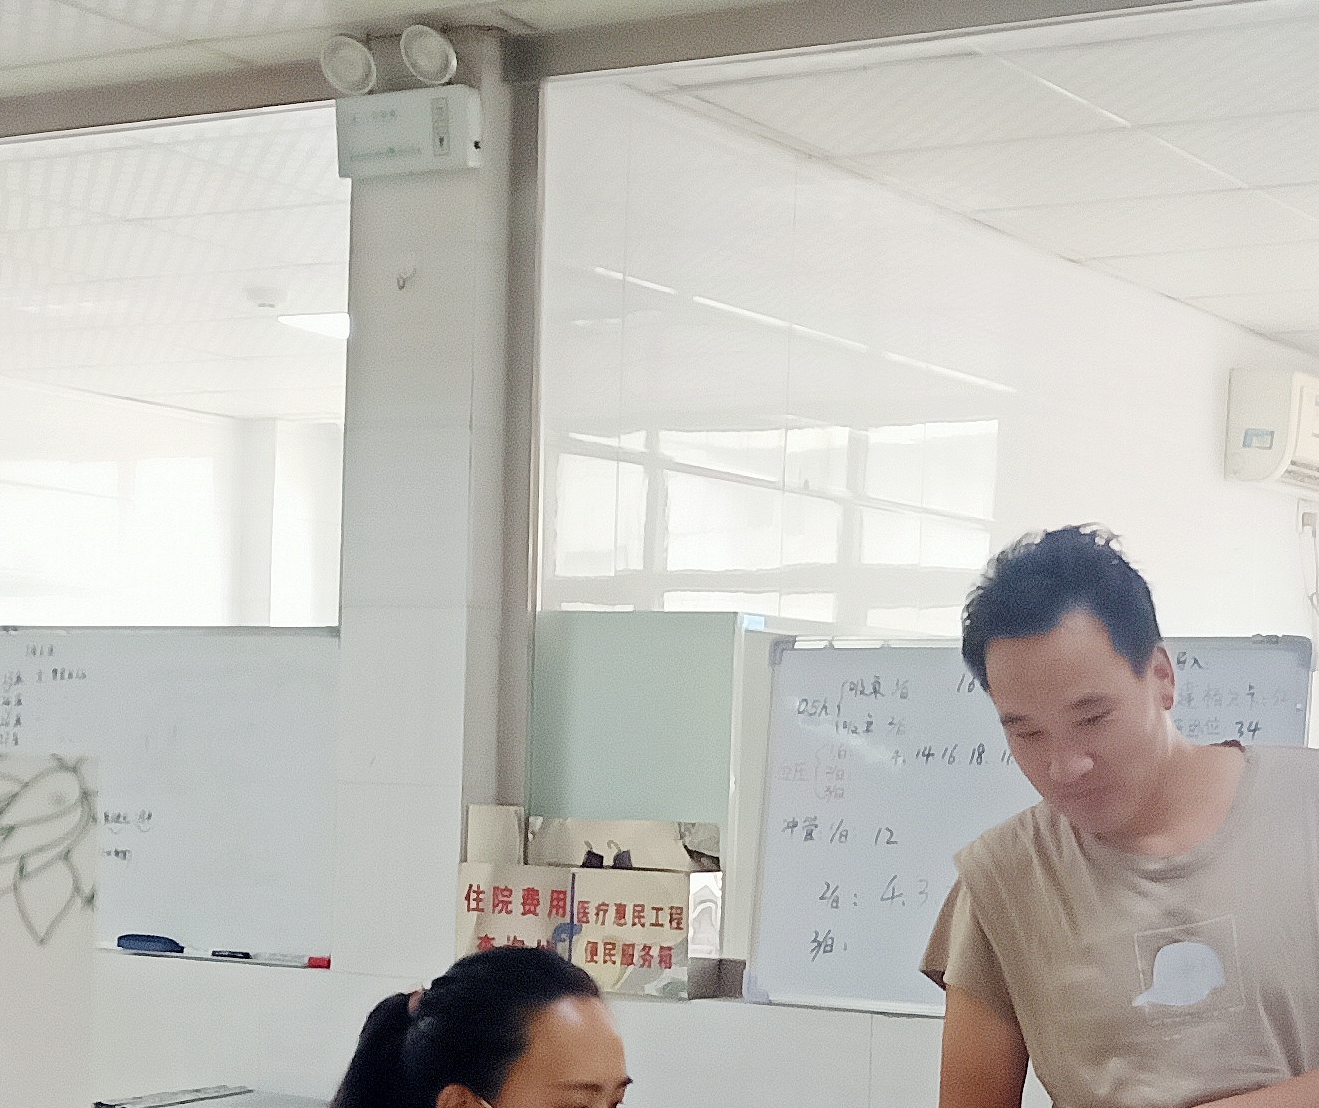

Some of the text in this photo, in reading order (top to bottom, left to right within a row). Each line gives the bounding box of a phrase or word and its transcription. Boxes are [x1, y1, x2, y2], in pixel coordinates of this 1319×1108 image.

[874, 827, 898, 846] 12
[464, 883, 568, 918] 住院费用
[576, 900, 684, 931] 医疗惠民工程
[584, 940, 674, 970] 便民服务箱
